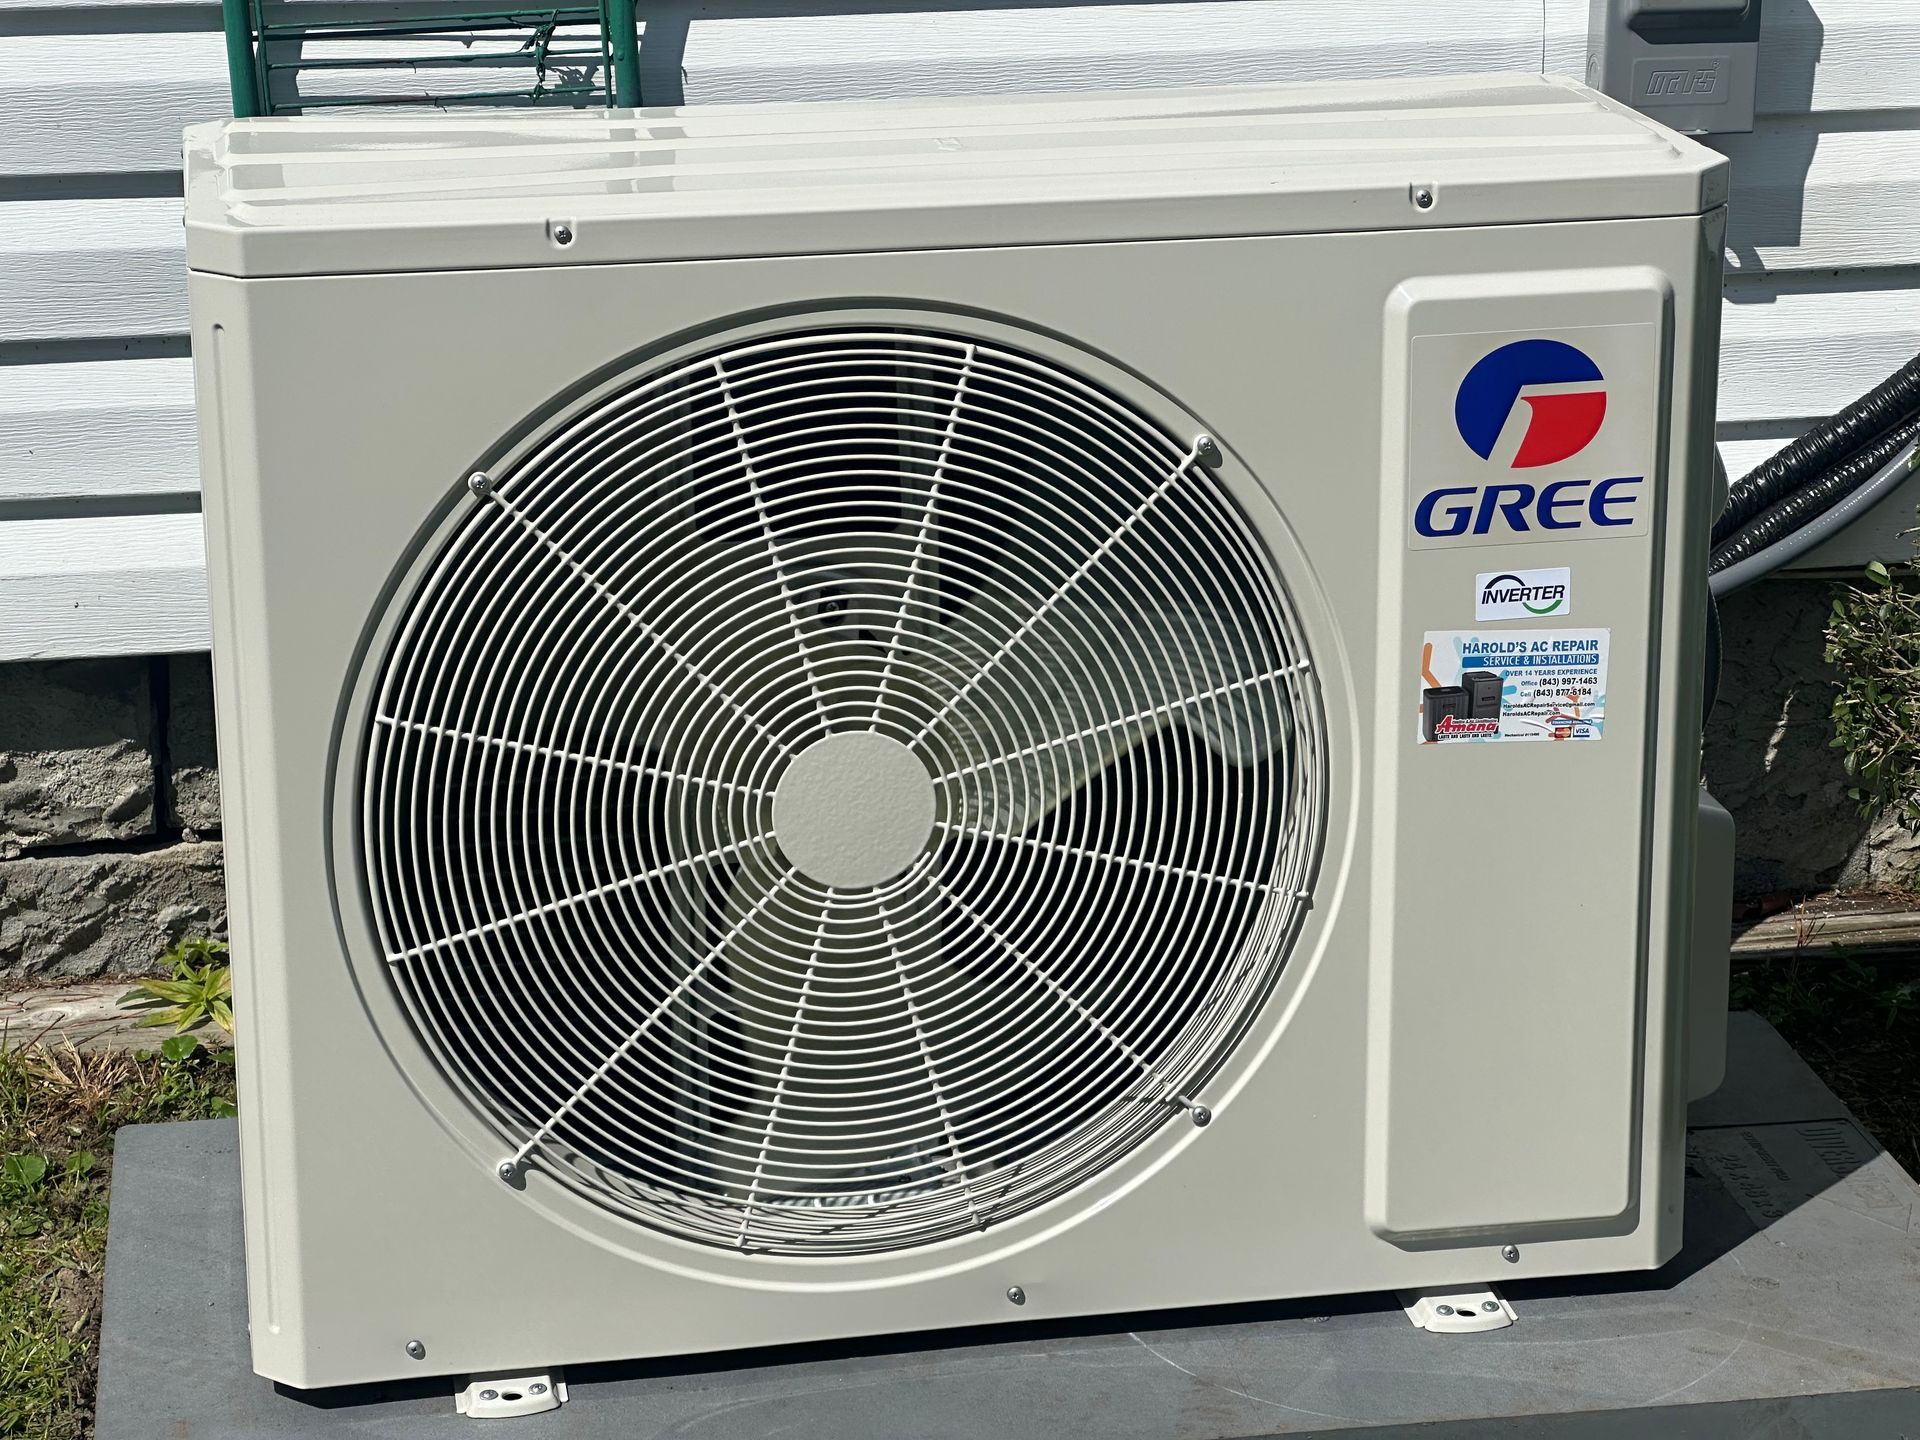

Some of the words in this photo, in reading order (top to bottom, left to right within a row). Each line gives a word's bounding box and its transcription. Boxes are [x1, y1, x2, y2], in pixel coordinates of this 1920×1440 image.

[1414, 476, 1644, 537] GREE
[1481, 584, 1565, 604] INVERTER
[1462, 641, 1527, 654] HAROLD'S
[1531, 641, 1548, 653] AC
[1552, 639, 1598, 652] REPAIR
[1483, 655, 1520, 667] SERVICE
[1523, 655, 1530, 665] &
[1533, 654, 1597, 665] INSTALLATIONS
[1539, 678, 1560, 687] (843)
[1561, 677, 1598, 685] 997-1463
[1533, 689, 1553, 698] (843)
[1555, 688, 1592, 697] 877-6184
[1435, 715, 1497, 733] Amana
